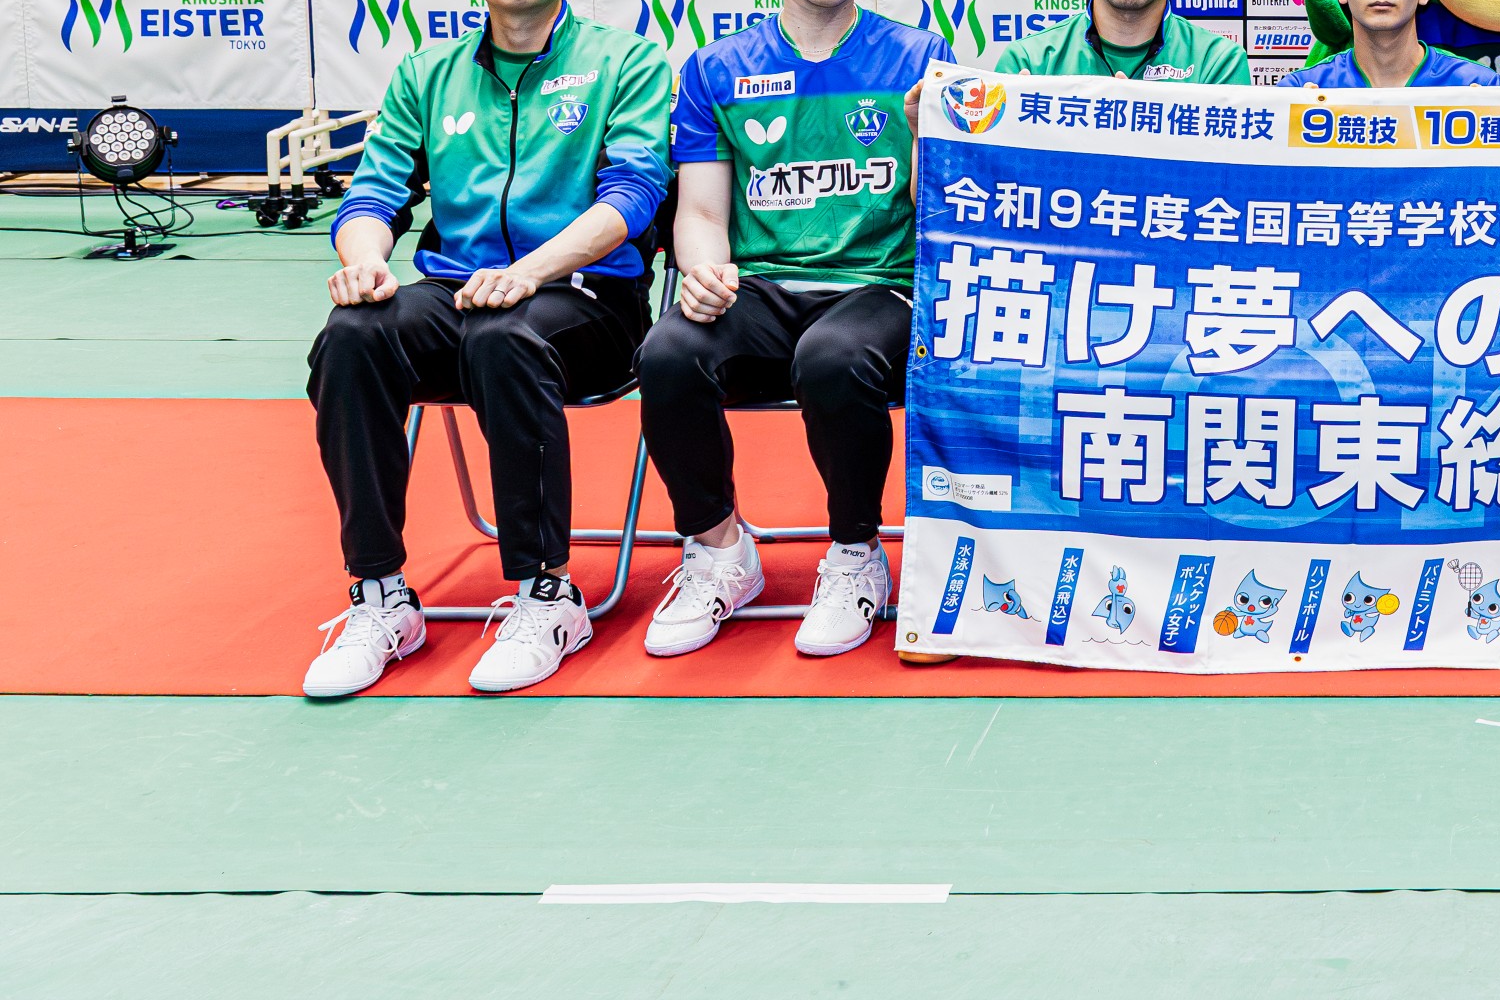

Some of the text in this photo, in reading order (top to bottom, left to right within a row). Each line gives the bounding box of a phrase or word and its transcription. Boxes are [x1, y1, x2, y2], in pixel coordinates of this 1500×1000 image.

[230, 40, 266, 50] TOKYO
[1018, 91, 1274, 141] 東京都開催競技
[1301, 112, 1397, 147] 9競技
[770, 161, 893, 195] 木下グループ
[785, 198, 812, 206] GROUP
[1185, 563, 1210, 629] バスケット
[1294, 564, 1324, 641] ハンドボール
[1408, 564, 1438, 643] バドミントン
